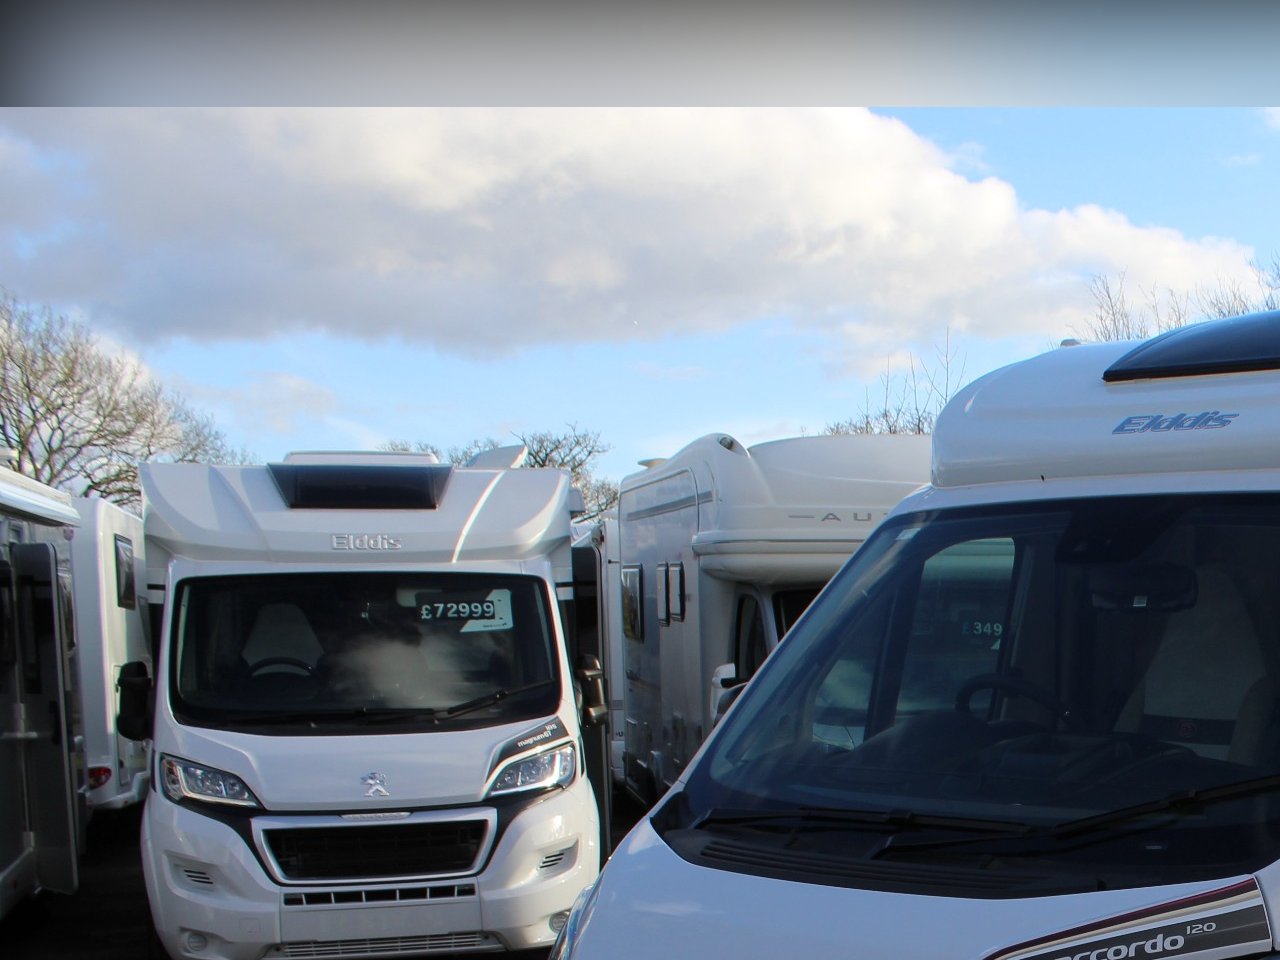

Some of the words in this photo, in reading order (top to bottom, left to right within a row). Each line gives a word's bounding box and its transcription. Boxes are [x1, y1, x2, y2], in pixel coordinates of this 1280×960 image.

[1111, 410, 1240, 435] Elddis
[331, 533, 402, 551] Elddis
[420, 602, 495, 620] £72999
[1186, 922, 1217, 935] 120
